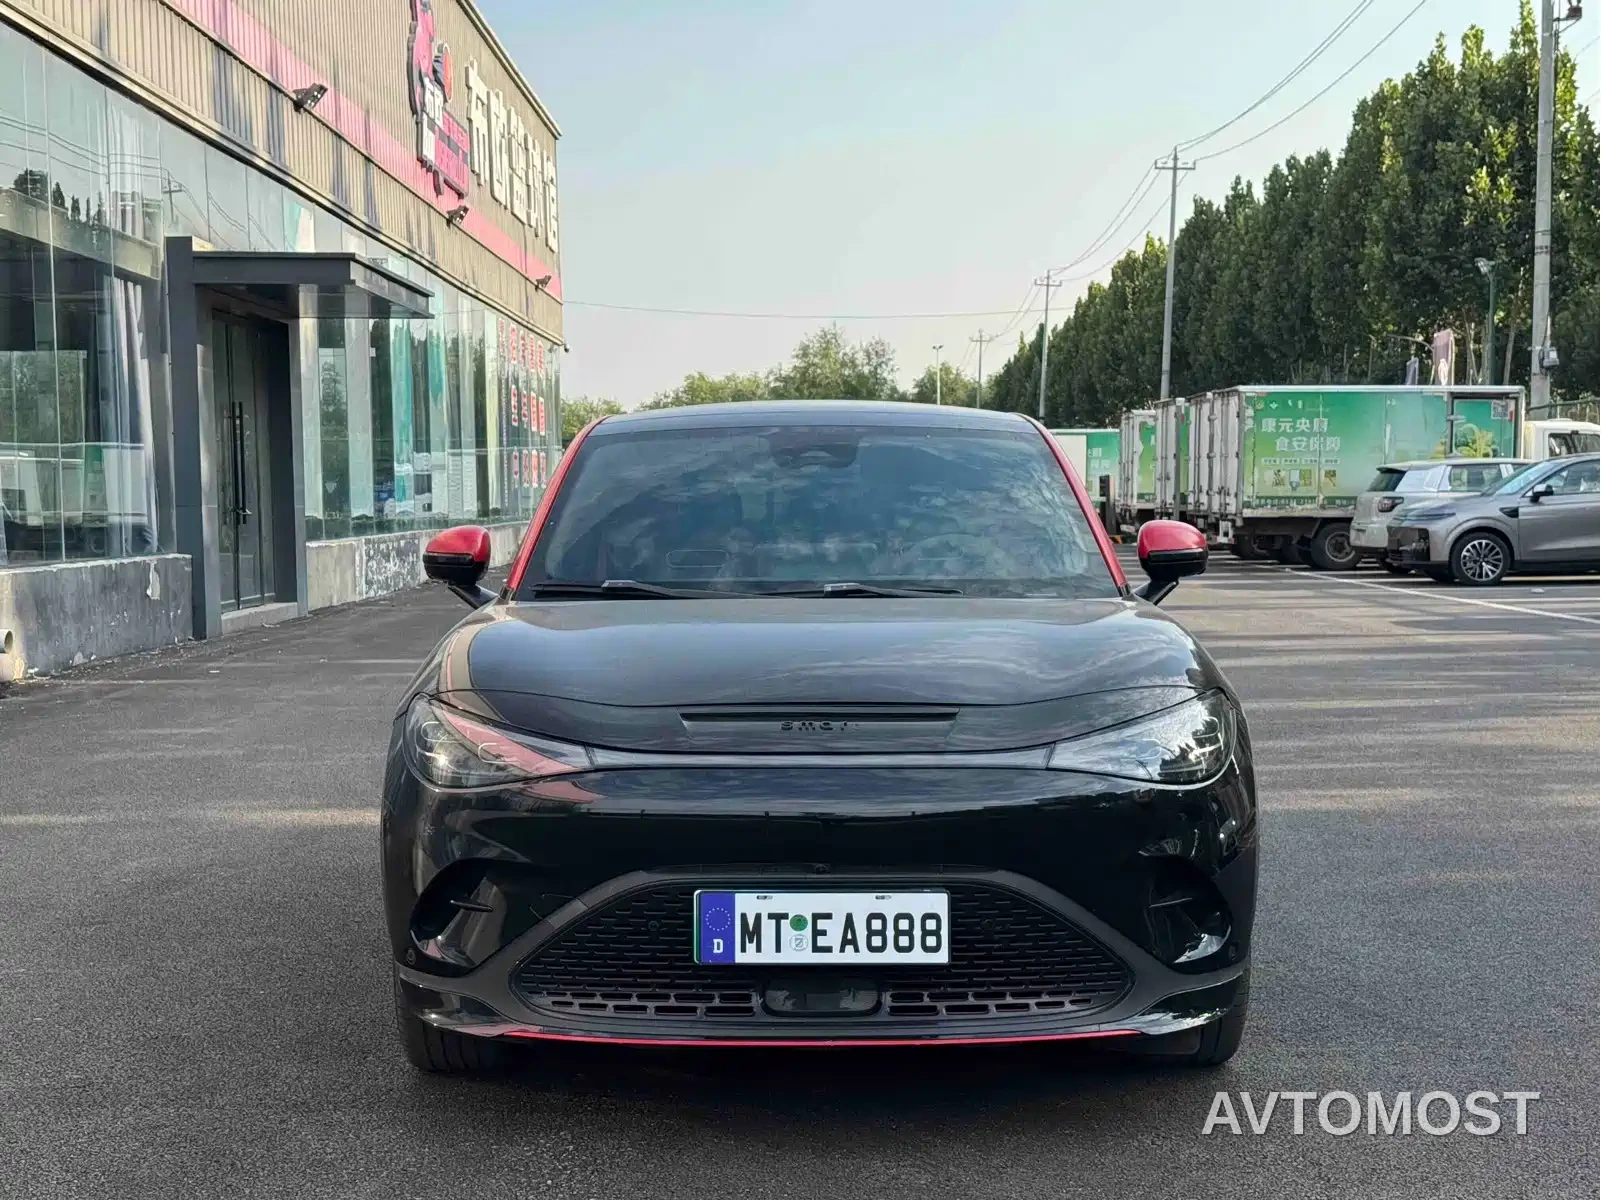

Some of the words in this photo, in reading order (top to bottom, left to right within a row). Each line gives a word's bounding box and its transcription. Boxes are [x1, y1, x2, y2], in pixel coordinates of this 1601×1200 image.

[712, 938, 724, 954] D
[740, 912, 789, 954] MT
[811, 912, 942, 954] EA888
